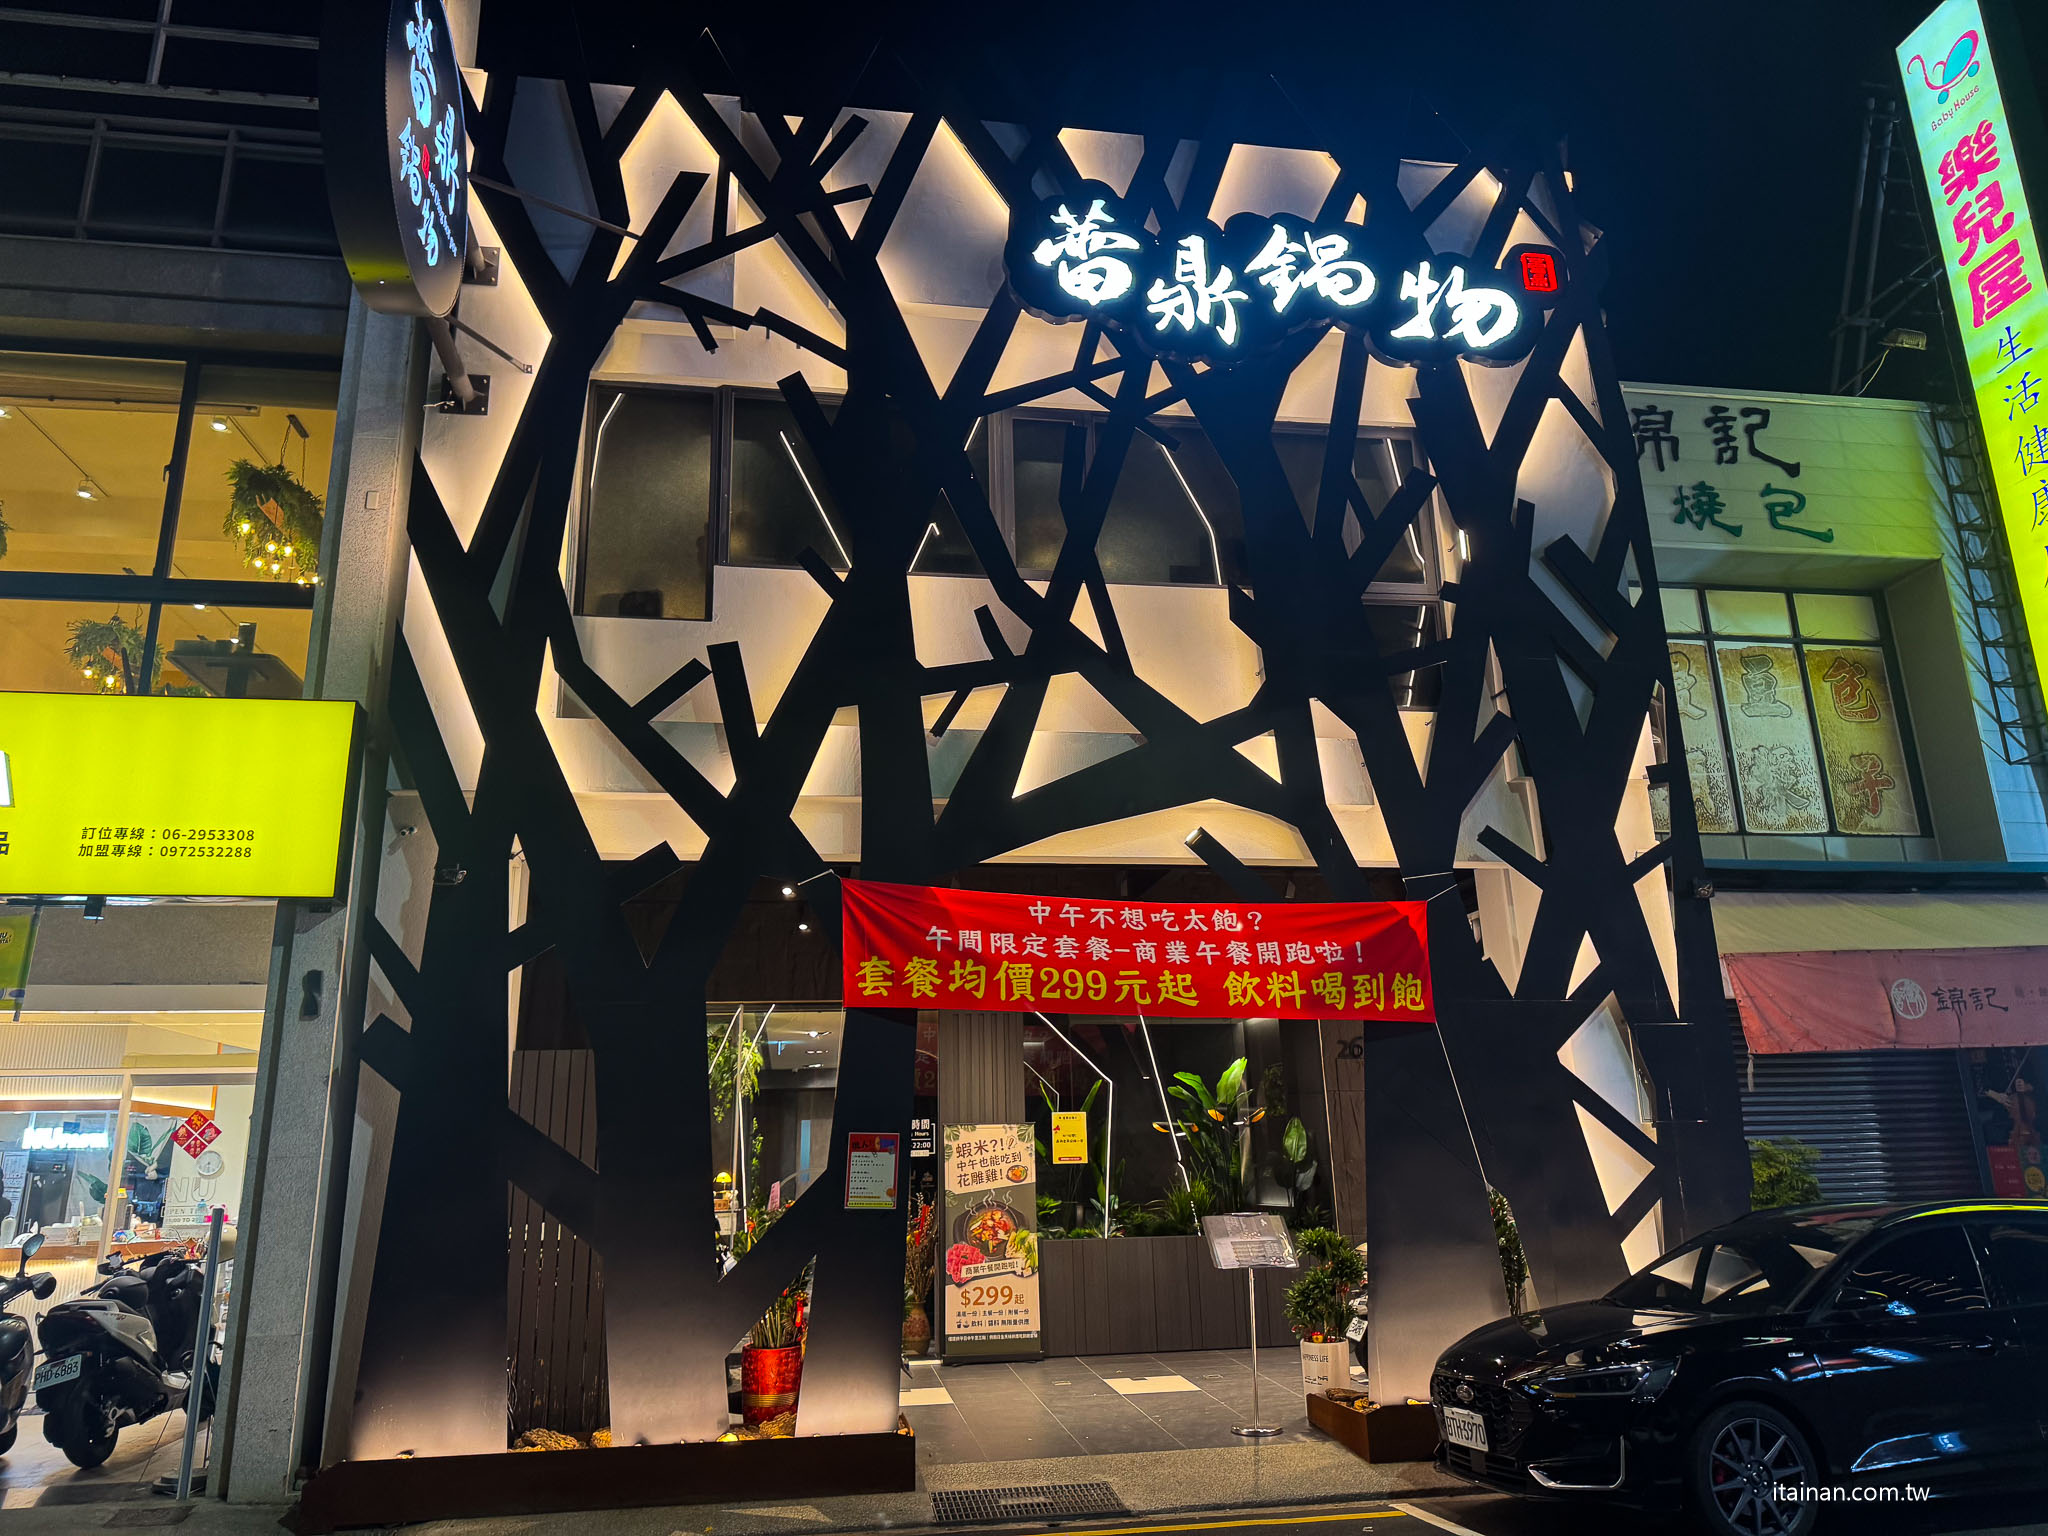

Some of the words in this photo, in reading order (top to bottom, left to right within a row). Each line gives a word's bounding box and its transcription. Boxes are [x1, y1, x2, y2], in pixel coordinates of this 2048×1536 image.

[1931, 108, 1954, 132] Baby
[1953, 85, 1980, 112] House
[1938, 119, 2033, 329] 樂兒屋
[1028, 900, 1263, 932] 中午不想吃太飽？
[855, 955, 1200, 1008] 套餐均價299元起
[1222, 969, 1426, 1012] 飲料喝到飽
[1931, 986, 2009, 1016] 錦記
[956, 1152, 1022, 1172] 中午也能吃到
